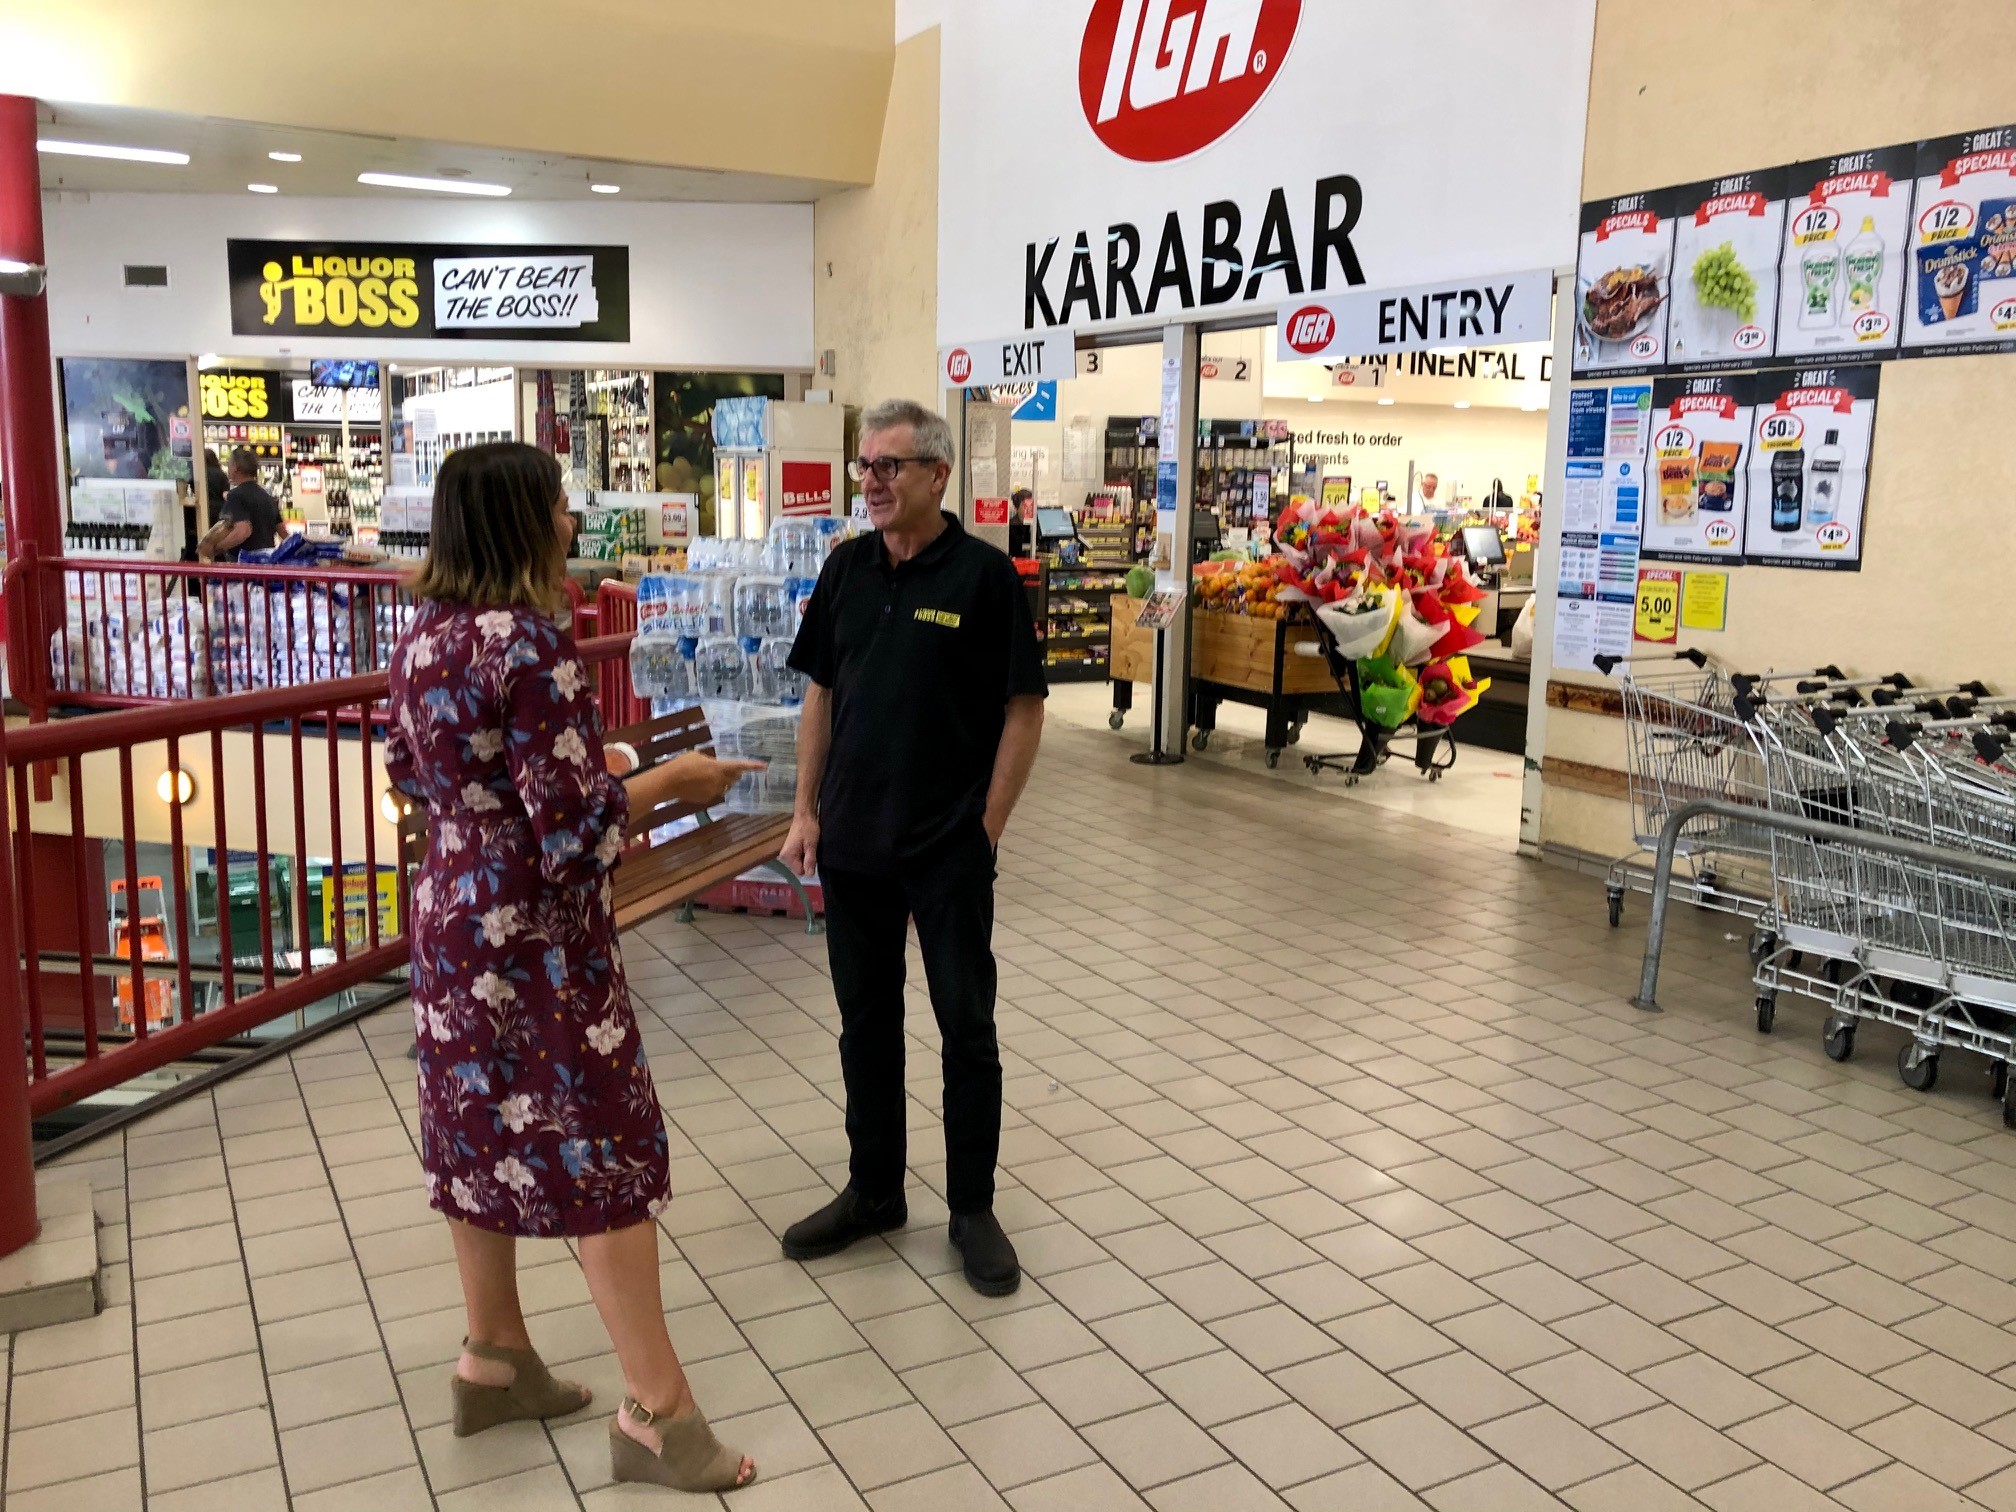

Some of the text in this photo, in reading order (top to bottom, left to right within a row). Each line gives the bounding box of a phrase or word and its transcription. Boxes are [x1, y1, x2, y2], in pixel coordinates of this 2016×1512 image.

[1097, 0, 1262, 124] IGA
[1973, 130, 2003, 151] GREAT
[1838, 154, 1866, 175] GREAT
[1720, 177, 1743, 196] GREAT
[1822, 174, 1879, 197] SPECIALS
[1618, 196, 1639, 214] GREAT
[1706, 195, 1755, 215] SPECIALS
[1605, 213, 1650, 232] SPECIALS
[1806, 211, 1827, 232] 1/2
[1934, 207, 1959, 229] 1/2
[1803, 231, 1828, 244] PRICE
[1930, 229, 1958, 241] PRICE
[1025, 174, 1366, 329] KARABAR
[1925, 247, 1978, 274] Drumstick
[293, 256, 415, 278] LIQUOR
[442, 265, 587, 290] CAN'T BEAT
[295, 277, 419, 328] BOSS
[447, 293, 576, 319] THE BOSS!!
[1378, 284, 1515, 346] ENTRY
[1288, 312, 1330, 347] IGA
[950, 354, 968, 377] IGA
[1003, 341, 1045, 378] EXIT
[1086, 352, 1099, 372] 3
[1235, 360, 1247, 380] 2
[1372, 368, 1379, 386] 1
[1801, 370, 1828, 387] GREAT
[199, 375, 265, 389] IQUOR
[1692, 378, 1715, 394] GREAT
[1680, 397, 1726, 412] SPECIALS
[1786, 390, 1841, 407] SPECIALS
[1317, 430, 1349, 445] fresh
[1353, 431, 1365, 445] to
[1369, 432, 1403, 446] order
[1666, 430, 1684, 448] 1/2
[783, 489, 830, 505] BELLS
[1641, 596, 1671, 614] 5.00
